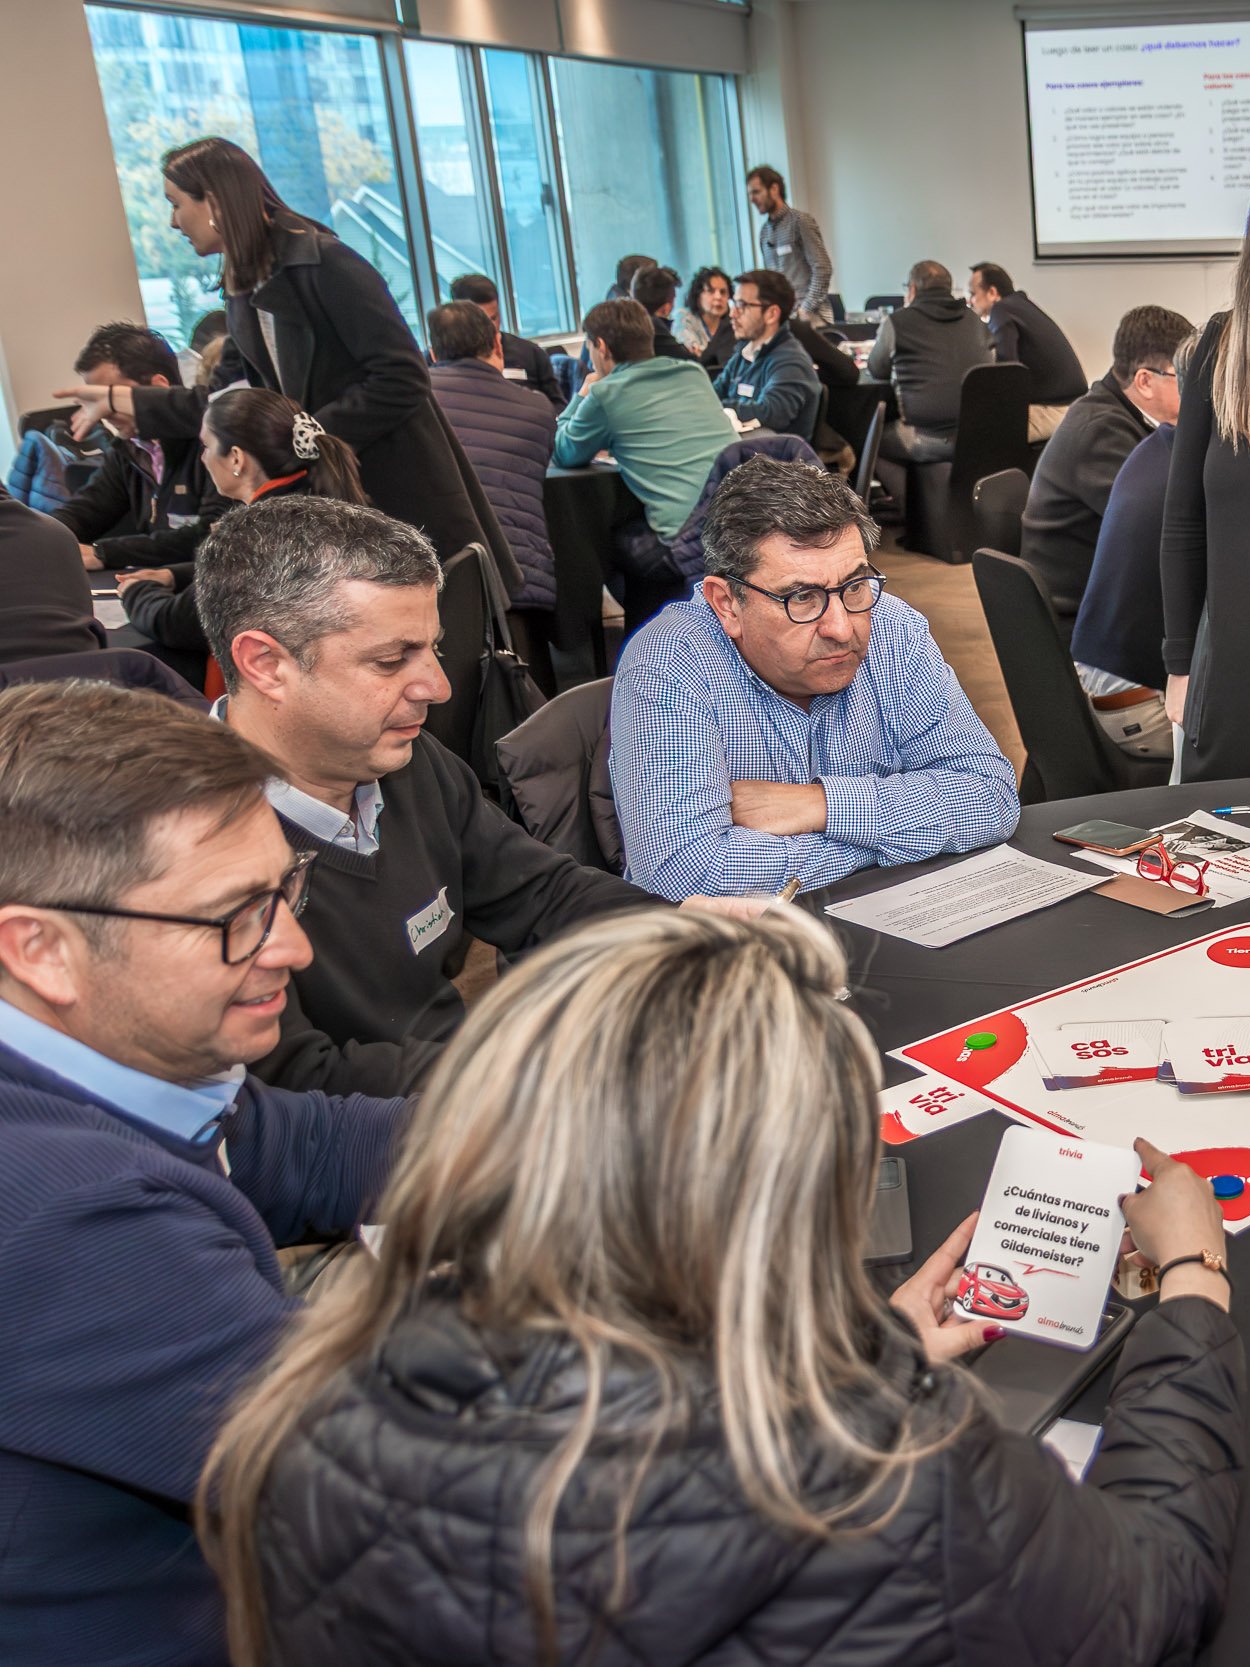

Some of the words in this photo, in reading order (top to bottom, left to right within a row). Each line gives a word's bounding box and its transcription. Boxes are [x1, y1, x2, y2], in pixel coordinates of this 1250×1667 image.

[1071, 1039, 1110, 1051] ca
[1076, 1047, 1129, 1060] sos
[1202, 1045, 1237, 1058] tri
[928, 1086, 966, 1104] tri
[1059, 1147, 1083, 1160] trivia
[1003, 1185, 1062, 1206] ¿Cuántas
[1063, 1199, 1110, 1218] marcas
[1015, 1205, 1031, 1217] de
[1032, 1207, 1080, 1229] livianos
[1080, 1221, 1090, 1234] y
[994, 1219, 1067, 1246] comerciales
[1069, 1235, 1101, 1253] tiene
[1000, 1238, 1085, 1268] Gildemeister?
[1037, 1315, 1084, 1335] almabrands
